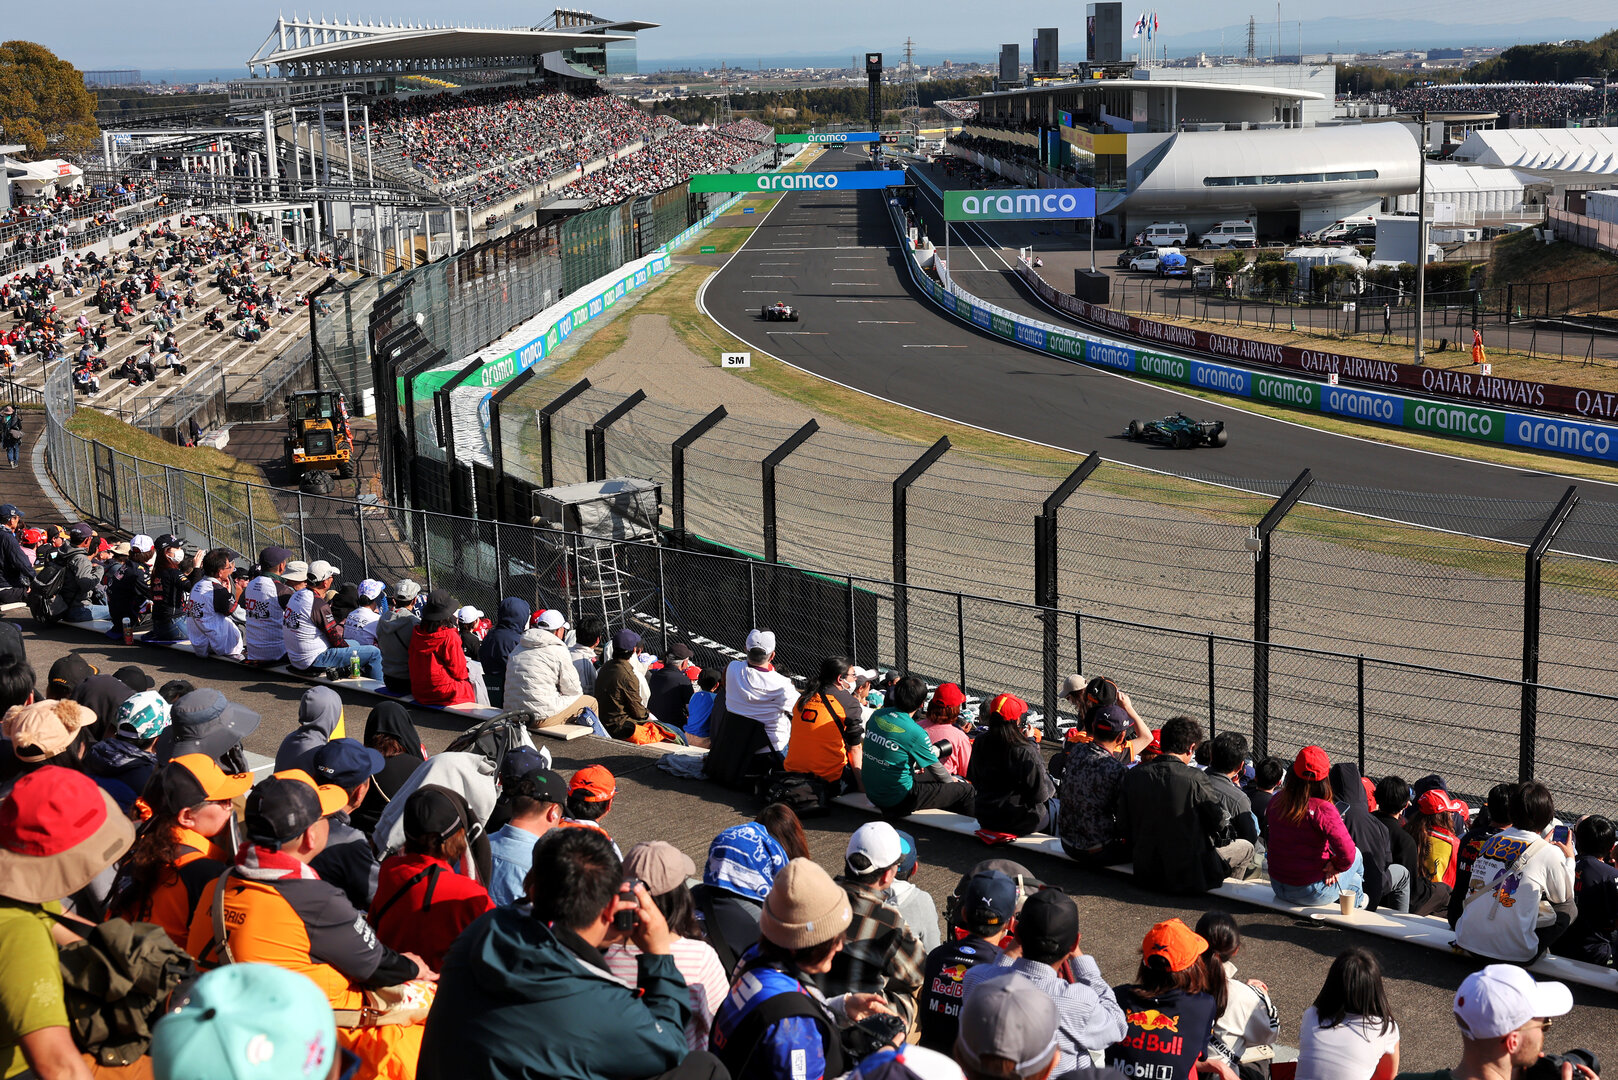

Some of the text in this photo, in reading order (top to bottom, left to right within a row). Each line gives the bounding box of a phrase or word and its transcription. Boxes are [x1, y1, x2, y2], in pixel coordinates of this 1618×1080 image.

[808, 134, 847, 142] aramco
[757, 174, 838, 189] aramco
[962, 194, 1077, 214] aramco
[1017, 325, 1043, 345] aramco
[1139, 320, 1195, 347] QATAR AIRWAYS
[520, 340, 542, 368] aramco
[1050, 335, 1080, 356] aramco
[1090, 345, 1129, 367] aramco
[1209, 334, 1283, 364] QATAR AIRWAYS
[481, 357, 514, 386] aramco
[728, 356, 745, 365] SM
[1141, 355, 1184, 378] aramco
[1301, 350, 1398, 383] QATAR AIRWAYS
[1197, 366, 1244, 391] aramco
[1422, 369, 1545, 406] QATAR AIRWAYS
[1259, 378, 1312, 405] aramco
[1329, 390, 1394, 419] aramco
[1414, 405, 1492, 435] aramco
[1518, 420, 1610, 454] aramco
[865, 729, 900, 751] aramco
[206, 905, 246, 925] NRRIS
[932, 977, 955, 997] Red
[929, 998, 959, 1017] Mobil
[1119, 1031, 1183, 1056] ed Bull
[1213, 1040, 1236, 1060] GUESS
[1113, 1058, 1155, 1079] Mobil
